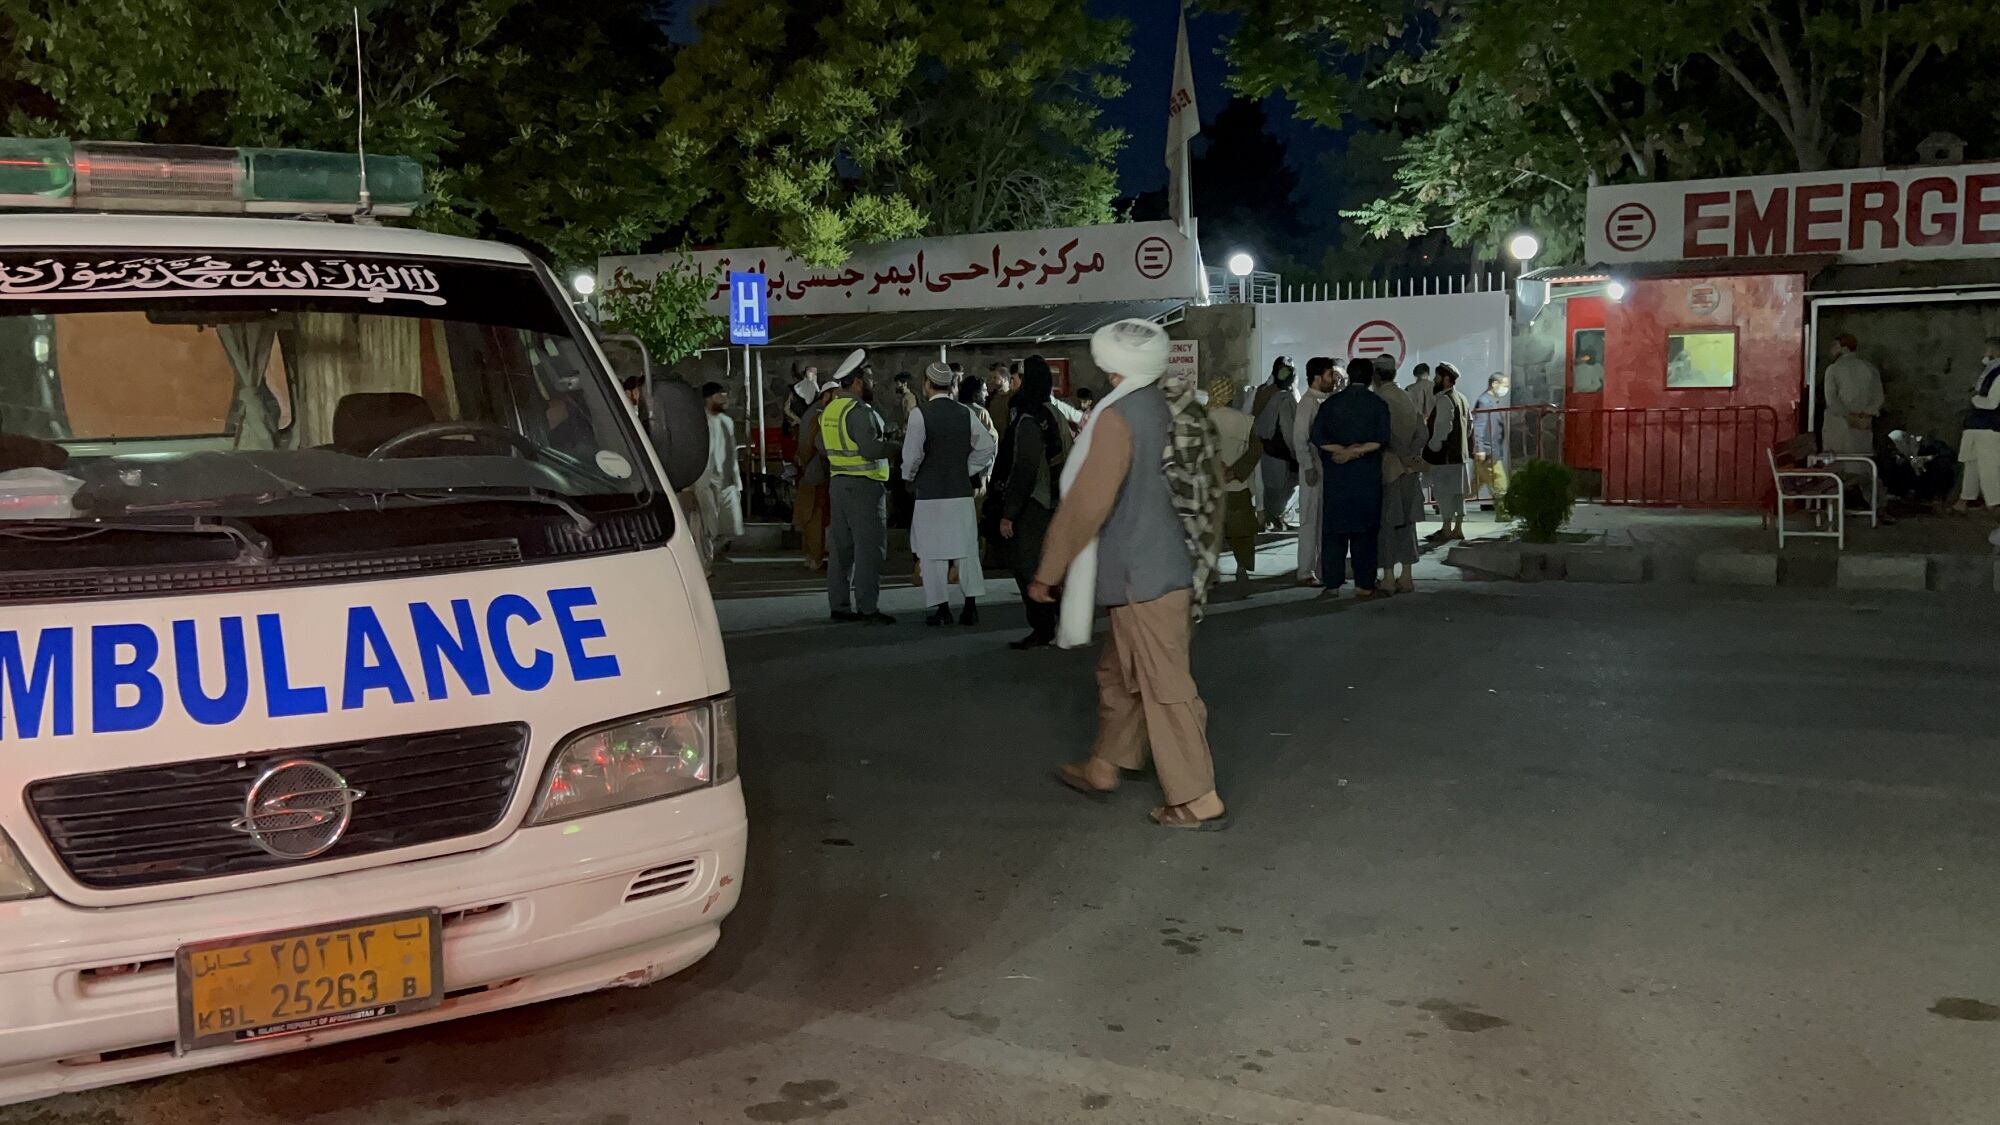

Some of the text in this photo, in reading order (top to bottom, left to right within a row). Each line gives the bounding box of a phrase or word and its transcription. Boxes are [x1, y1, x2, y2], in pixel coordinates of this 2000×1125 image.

[1683, 173, 2000, 258] EMERGE
[925, 243, 1036, 293] جراحی
[1035, 237, 1105, 285] مرکز
[738, 281, 760, 323] H
[1168, 356, 1194, 364] EAPONS
[1172, 344, 1193, 353] ENCY
[198, 969, 417, 1031] KBL 25263 B
[257, 1009, 375, 1036] ISLAMIC REPUBLIC OF AFGHANISTAN
